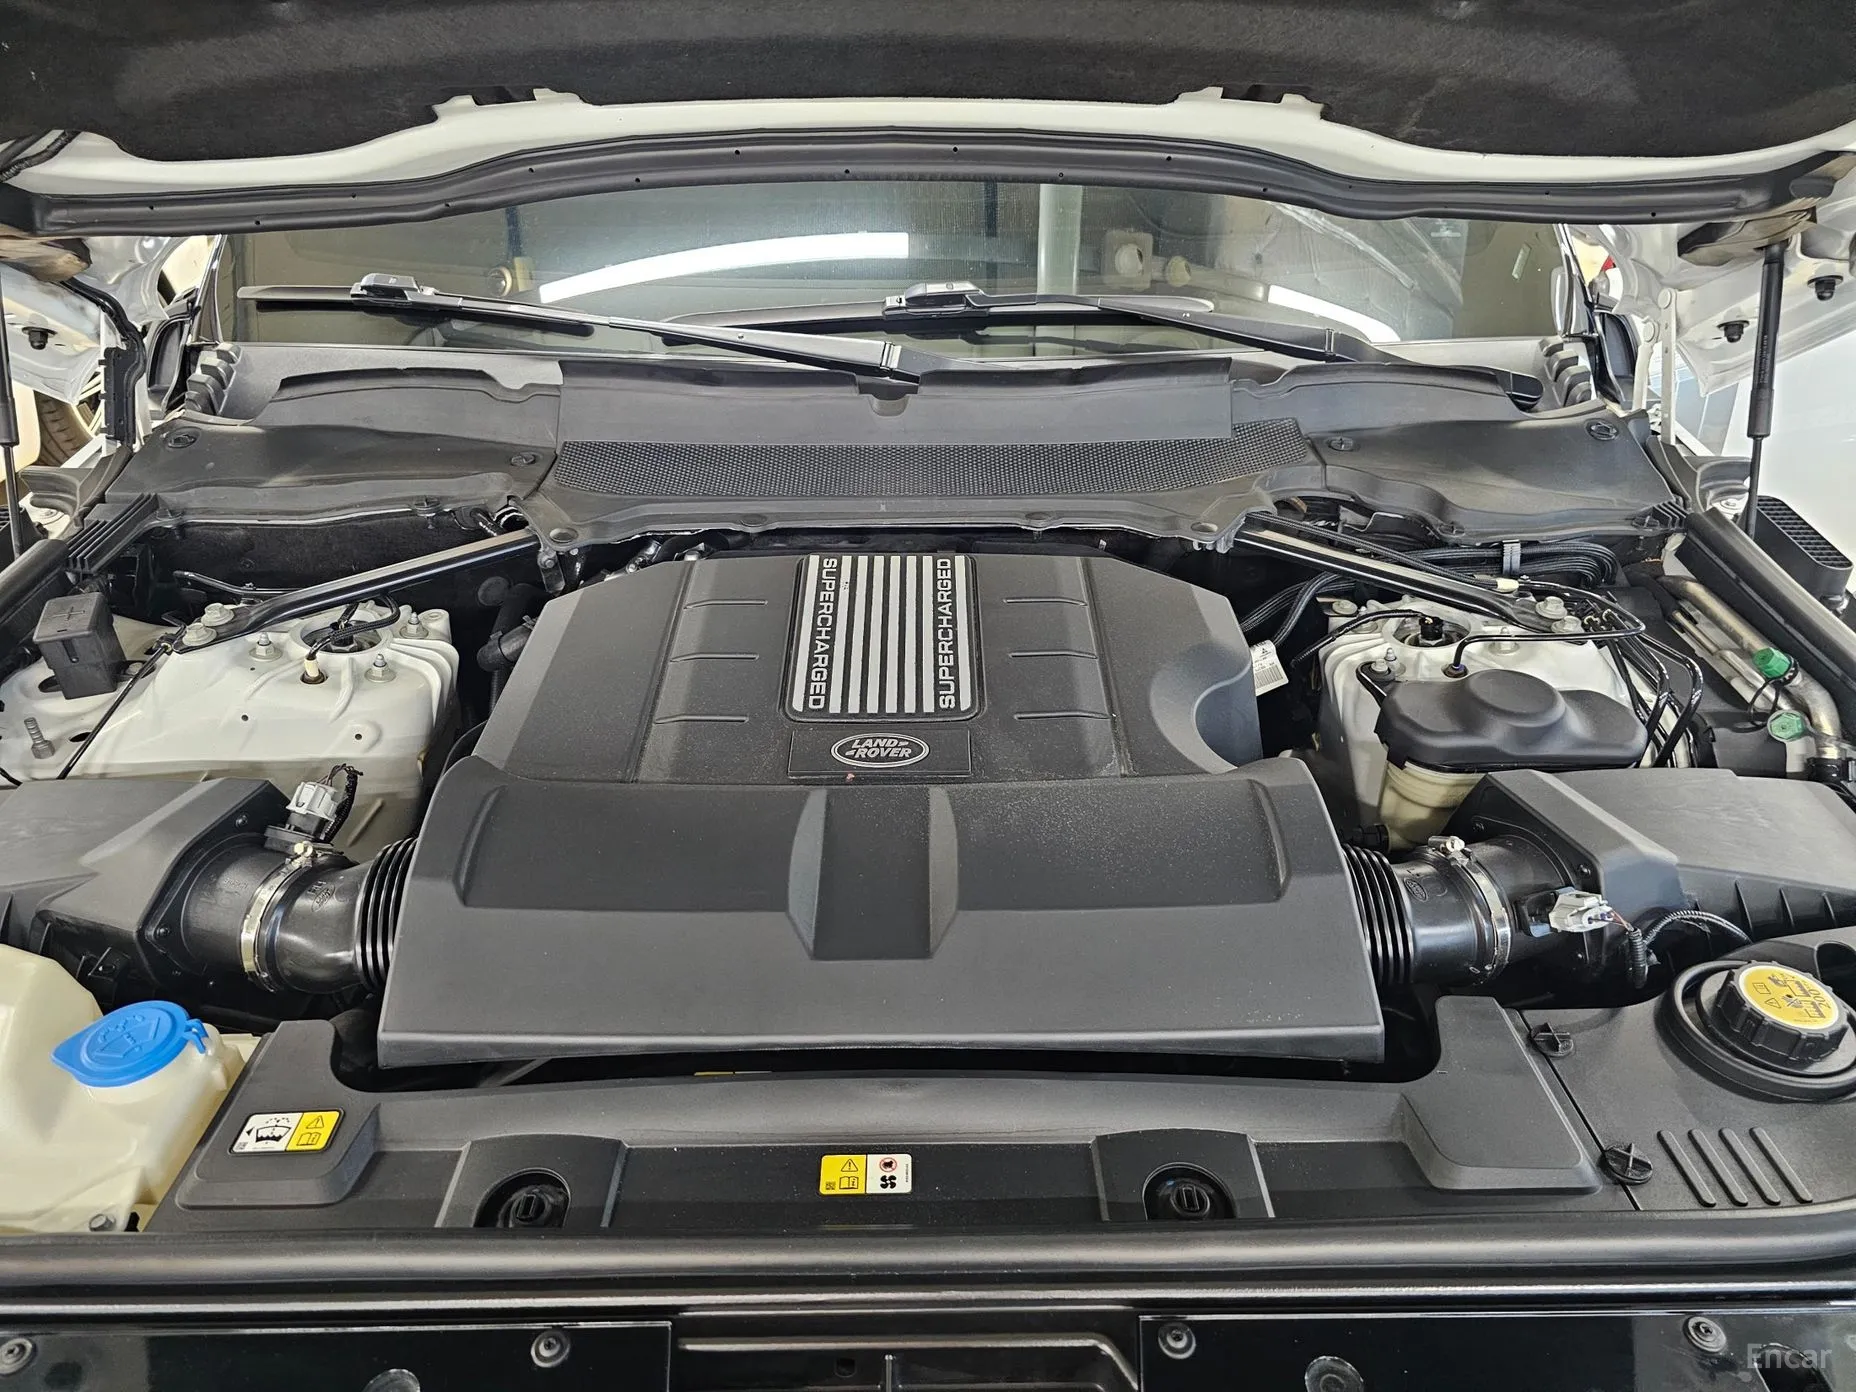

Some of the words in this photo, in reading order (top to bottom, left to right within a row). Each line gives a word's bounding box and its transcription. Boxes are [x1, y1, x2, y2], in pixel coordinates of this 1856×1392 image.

[808, 558, 837, 710] SUPERCHARGED
[936, 558, 956, 709] SUPERCHARGED
[851, 738, 898, 749] LAND
[854, 748, 912, 758] ROVER
